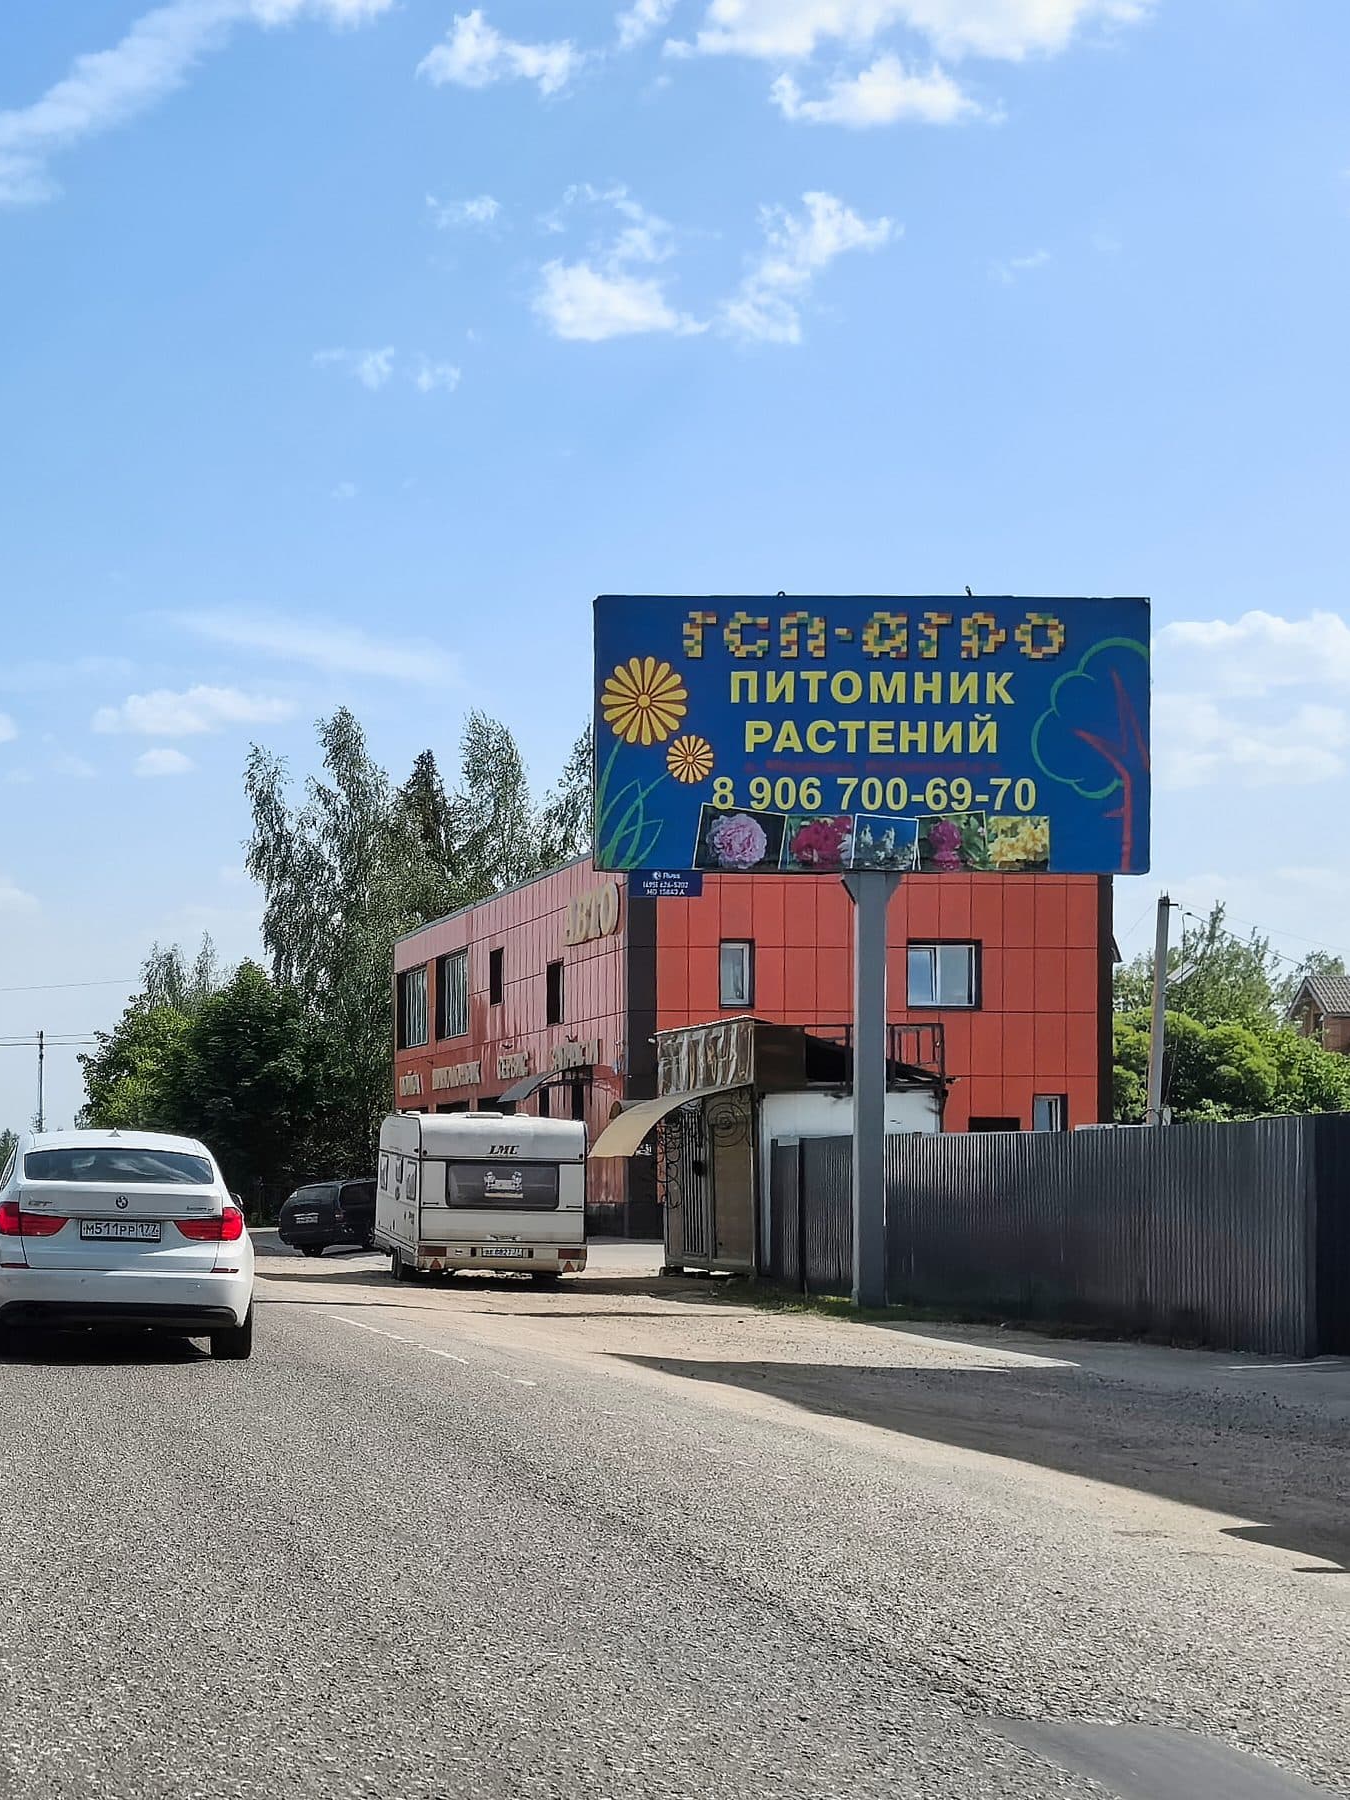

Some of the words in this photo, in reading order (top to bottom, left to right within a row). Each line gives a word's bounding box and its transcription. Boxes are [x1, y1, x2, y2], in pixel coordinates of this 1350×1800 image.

[729, 670, 1014, 705] ПИТОМНИК
[743, 713, 998, 754] РАСТЕНИЙ
[712, 776, 735, 811] 8
[749, 776, 822, 811] 906
[837, 776, 1037, 811] 700-69-70
[564, 881, 620, 945] АВТО
